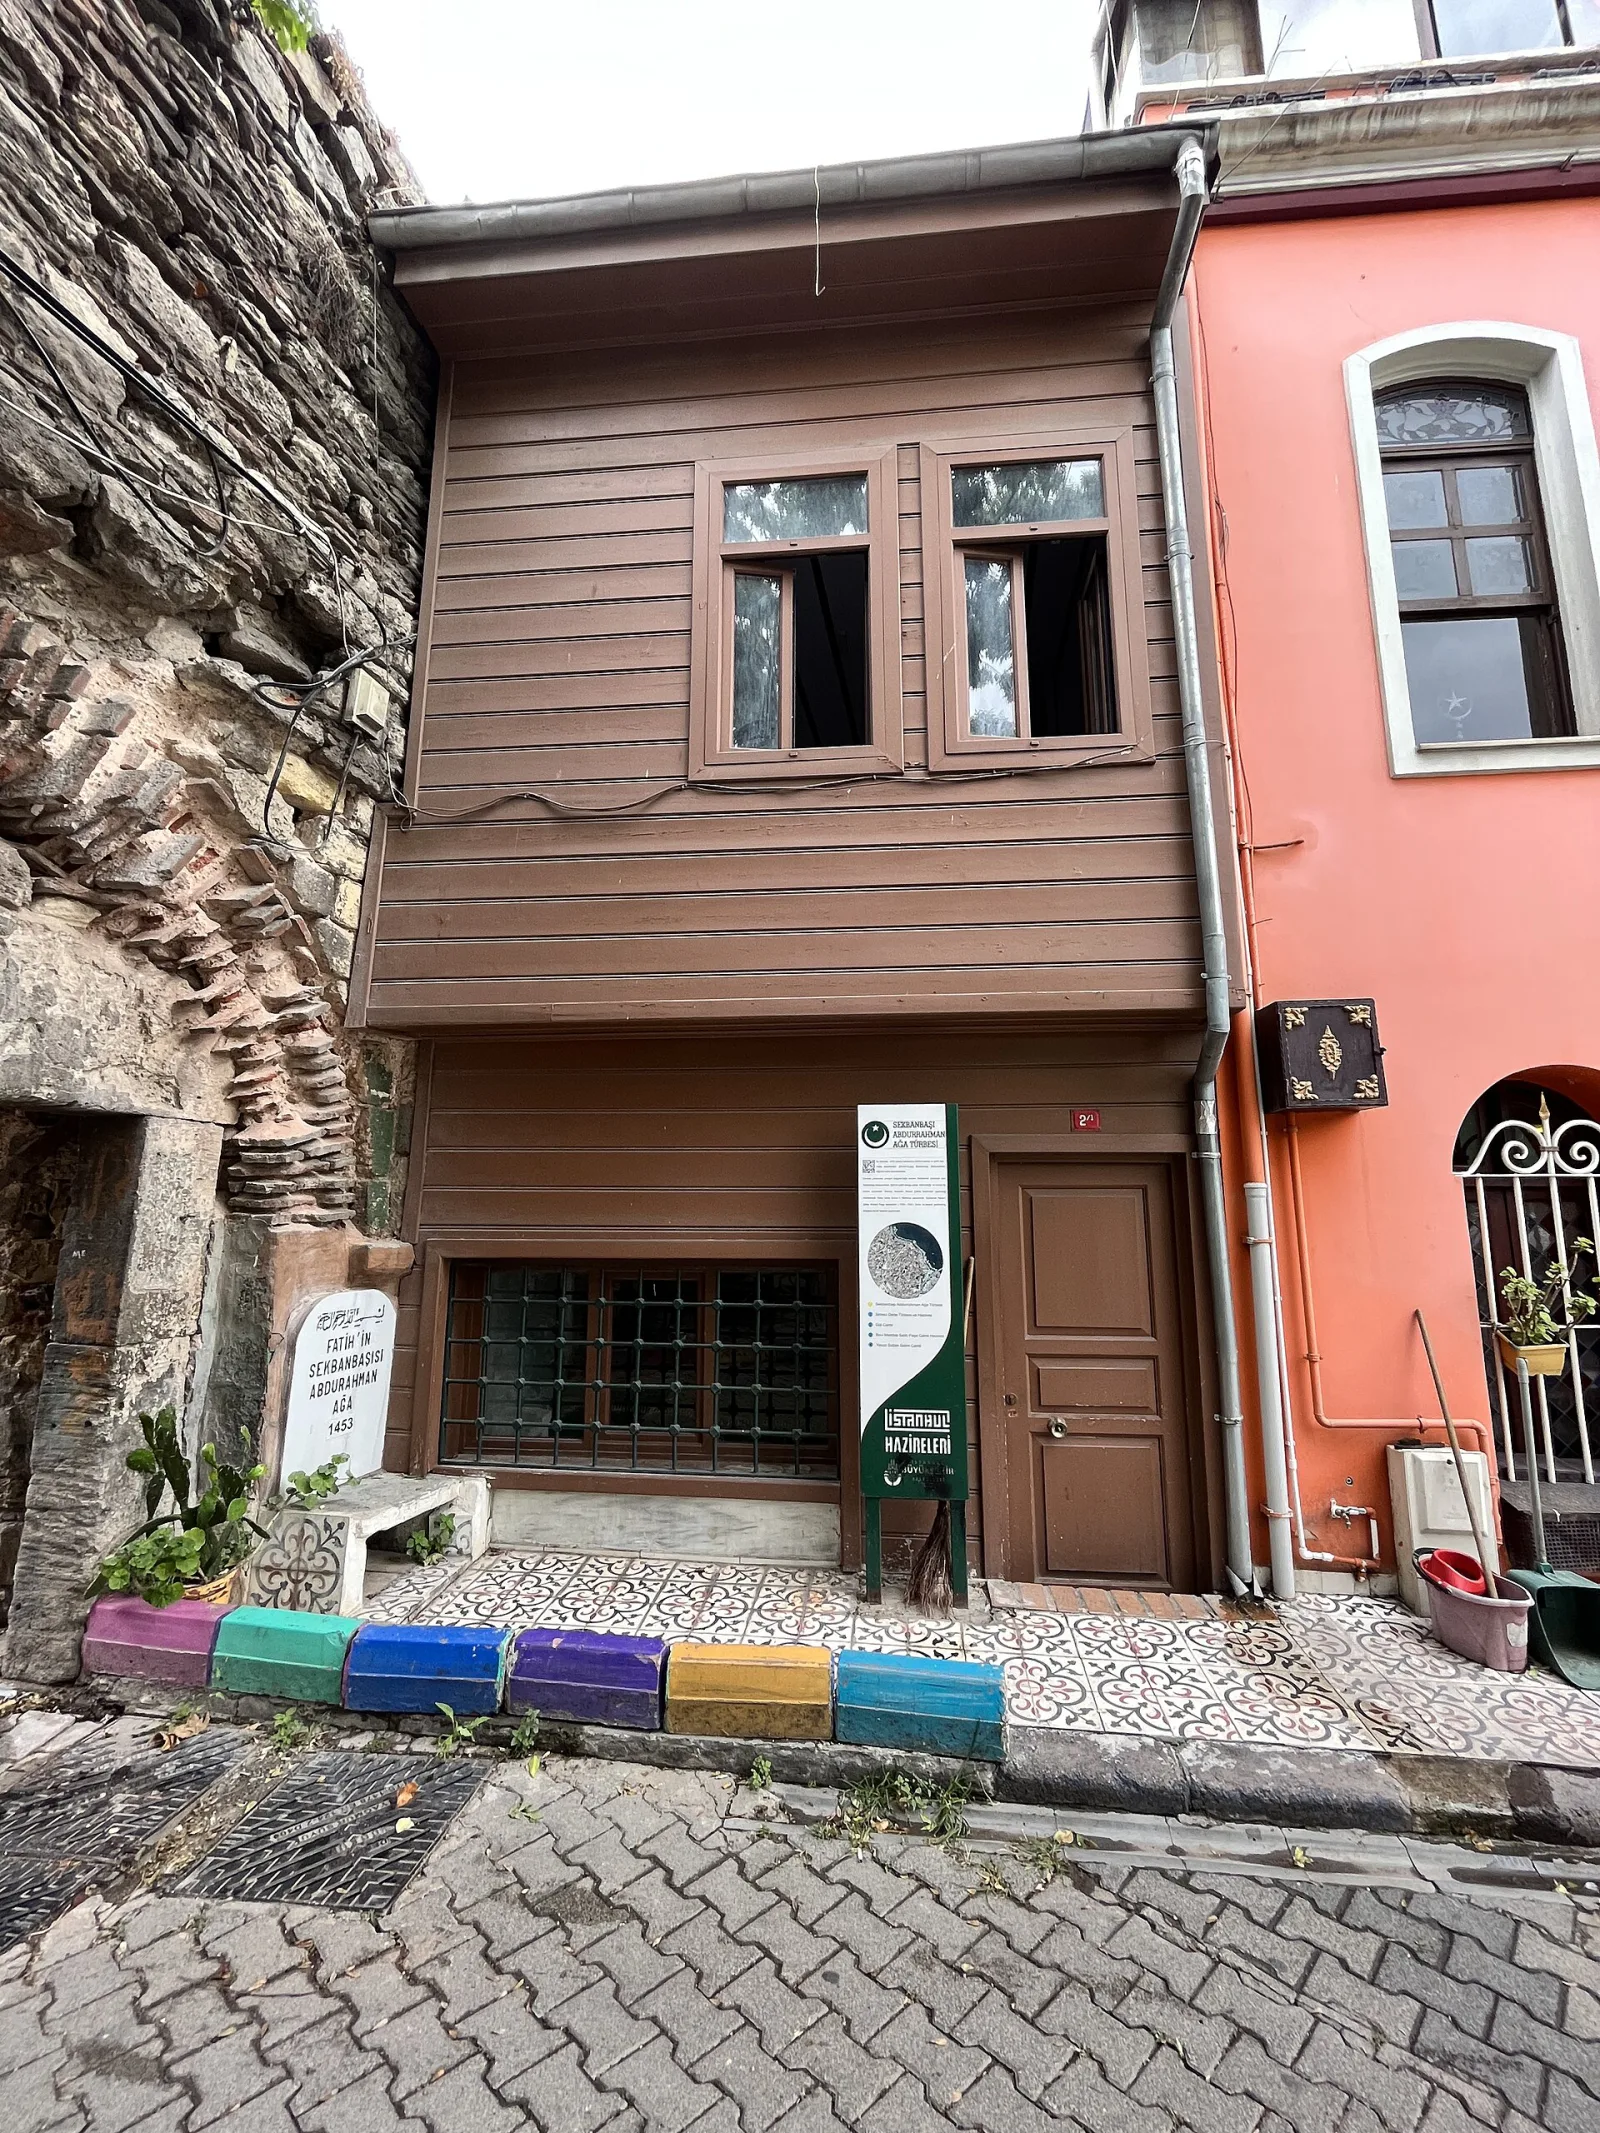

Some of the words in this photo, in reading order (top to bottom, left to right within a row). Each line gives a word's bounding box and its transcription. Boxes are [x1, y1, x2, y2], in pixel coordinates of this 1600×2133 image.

[892, 1130, 945, 1138] ABDURRAHMAN
[892, 1139, 908, 1148] AĞA
[909, 1139, 939, 1148] TÜRBESİ
[309, 1349, 384, 1378] SEKBANBAŞISI
[309, 1369, 378, 1400] ABDURAHMAN
[332, 1395, 353, 1415] AĞA
[328, 1417, 354, 1436] 1453
[901, 1463, 955, 1476] BÜYÜİR
